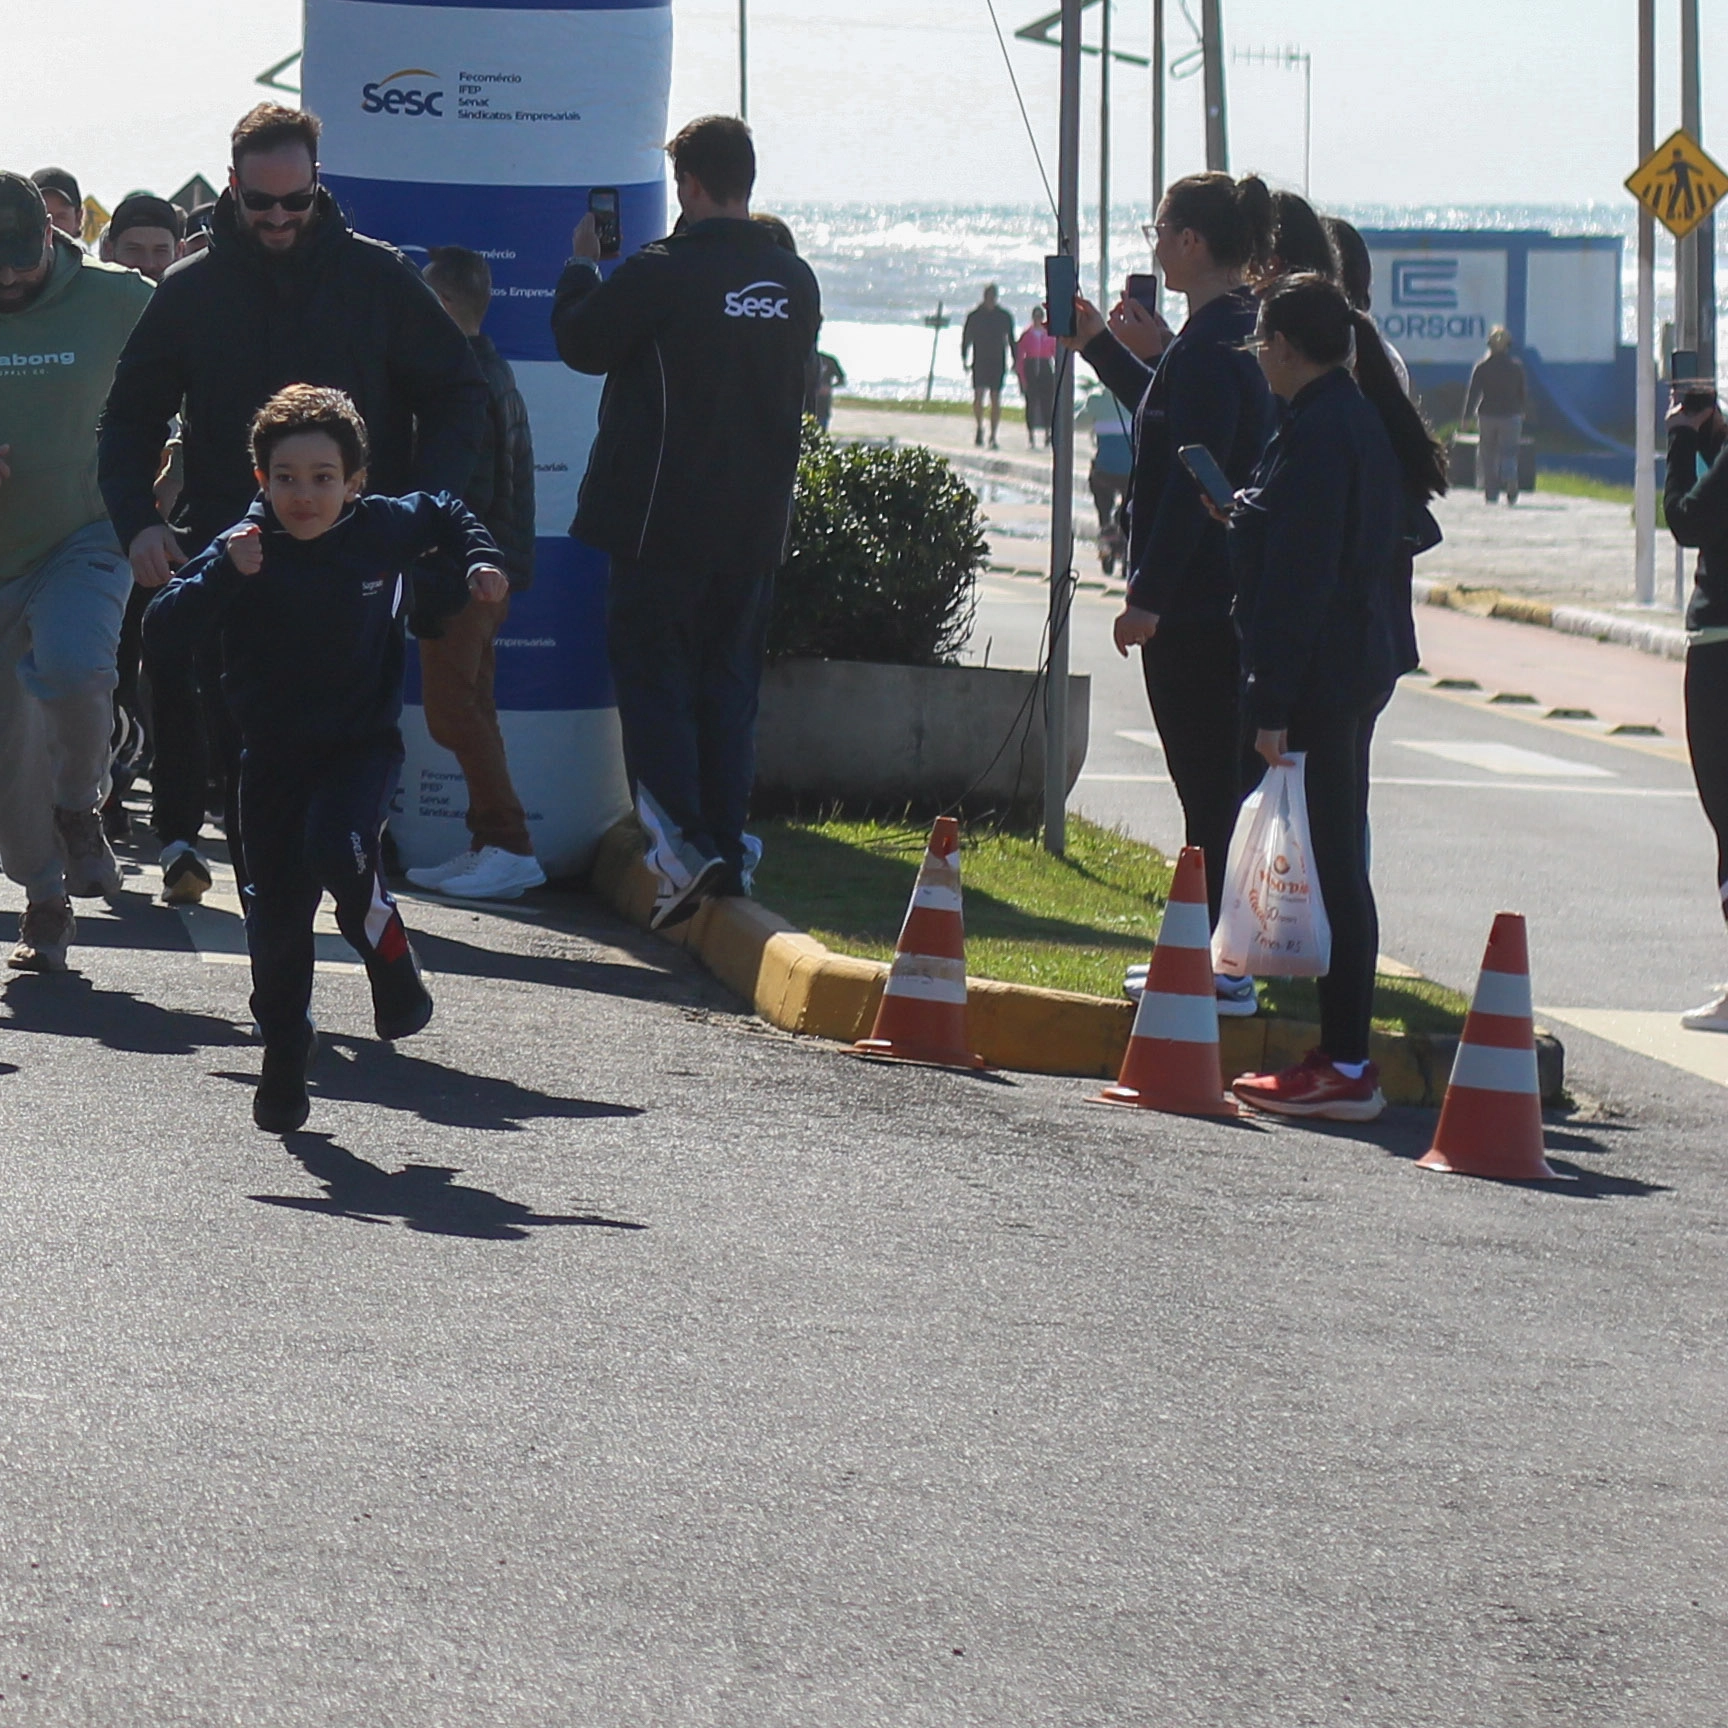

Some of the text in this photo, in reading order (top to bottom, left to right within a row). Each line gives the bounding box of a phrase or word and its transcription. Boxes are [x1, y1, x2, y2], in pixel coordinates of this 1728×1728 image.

[459, 71, 522, 85] Fecomércio
[458, 84, 482, 96] IFEP
[361, 83, 443, 118] Sesc
[457, 108, 582, 122] Sindicatos Empresariais
[724, 291, 789, 320] Sesc
